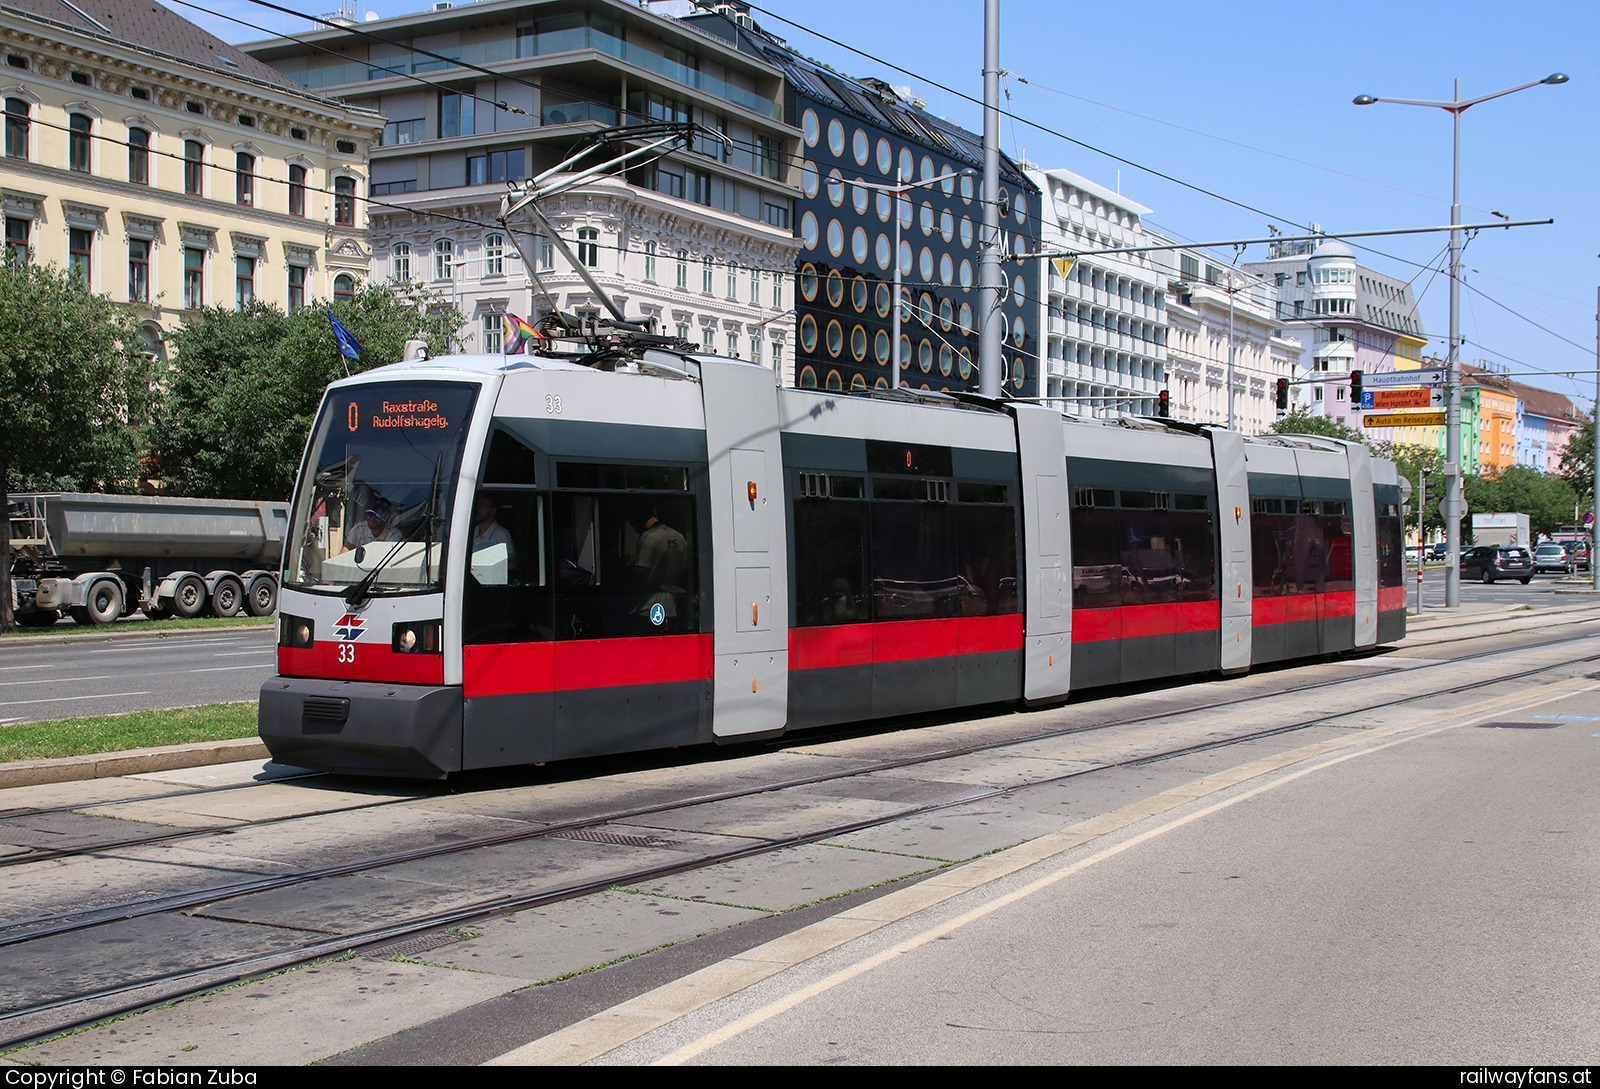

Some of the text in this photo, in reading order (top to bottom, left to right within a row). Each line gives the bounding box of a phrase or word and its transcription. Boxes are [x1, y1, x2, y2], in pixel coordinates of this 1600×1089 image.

[1373, 375, 1421, 384] Hauptbahnhof
[1382, 390, 1408, 398] Bahnhof
[382, 399, 438, 413] Raxstraße
[545, 393, 562, 414] 33
[372, 414, 449, 429] Rudolfshügelg.
[1393, 416, 1402, 424] im
[1403, 415, 1434, 425] Reisezug
[337, 643, 355, 664] 33
